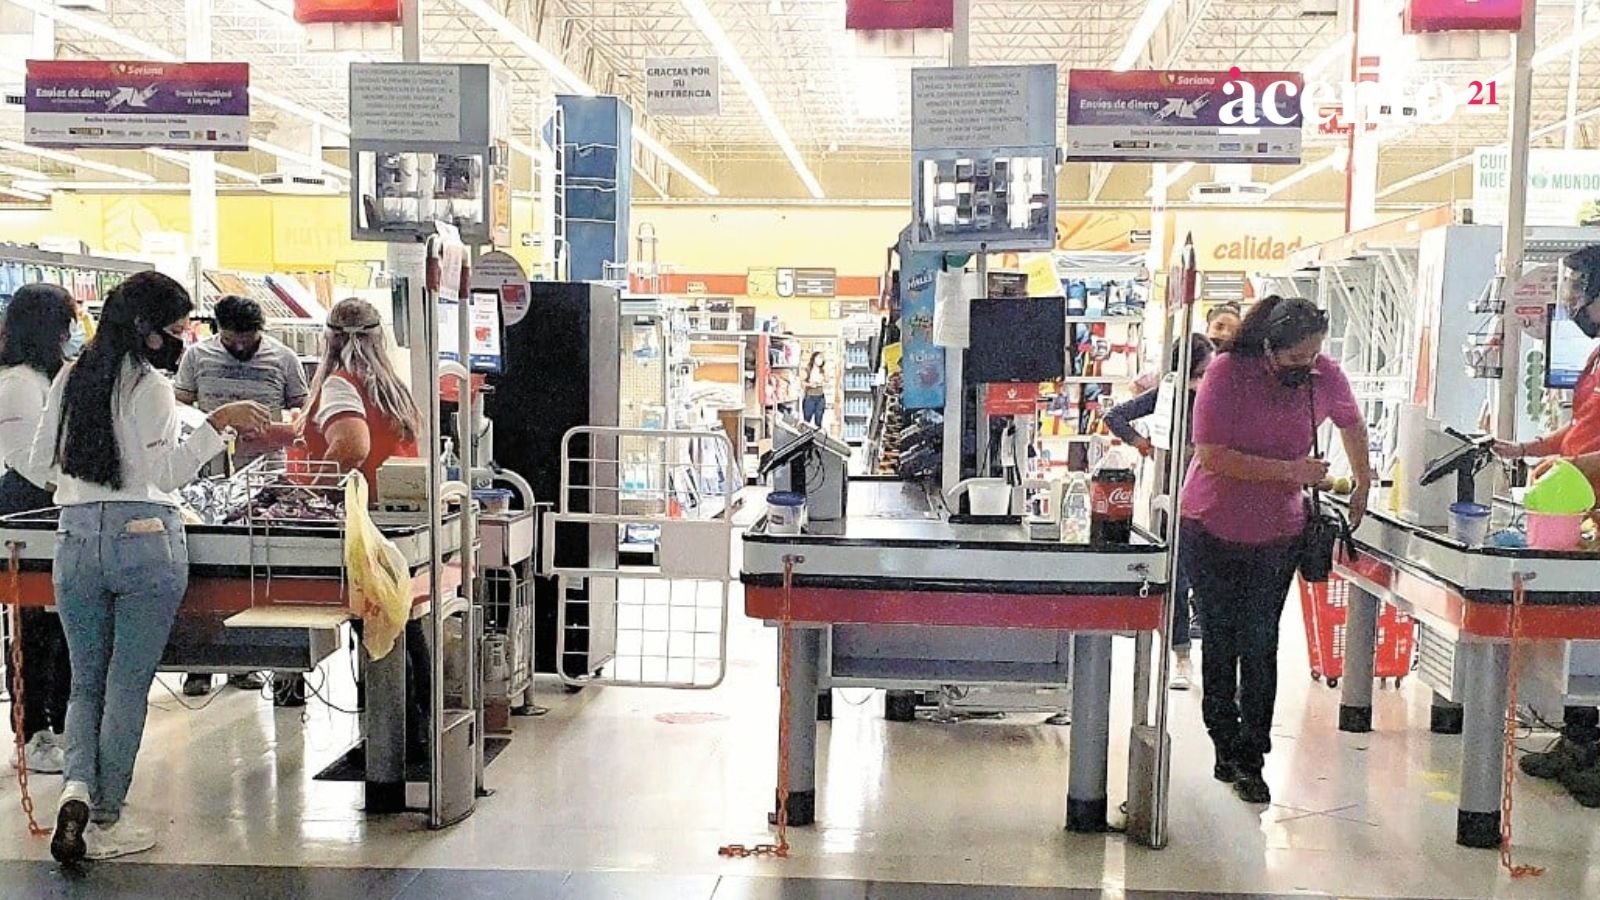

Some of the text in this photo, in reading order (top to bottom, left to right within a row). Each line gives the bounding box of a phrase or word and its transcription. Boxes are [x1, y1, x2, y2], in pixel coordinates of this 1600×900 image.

[646, 67, 710, 77] GRACIAS POR
[672, 79, 685, 87] SU
[1176, 75, 1216, 86] Soriana
[647, 89, 711, 98] PREFERENCIA
[1114, 98, 1126, 110] de
[1127, 98, 1160, 110] dinero
[1551, 173, 1600, 190] MUNDO
